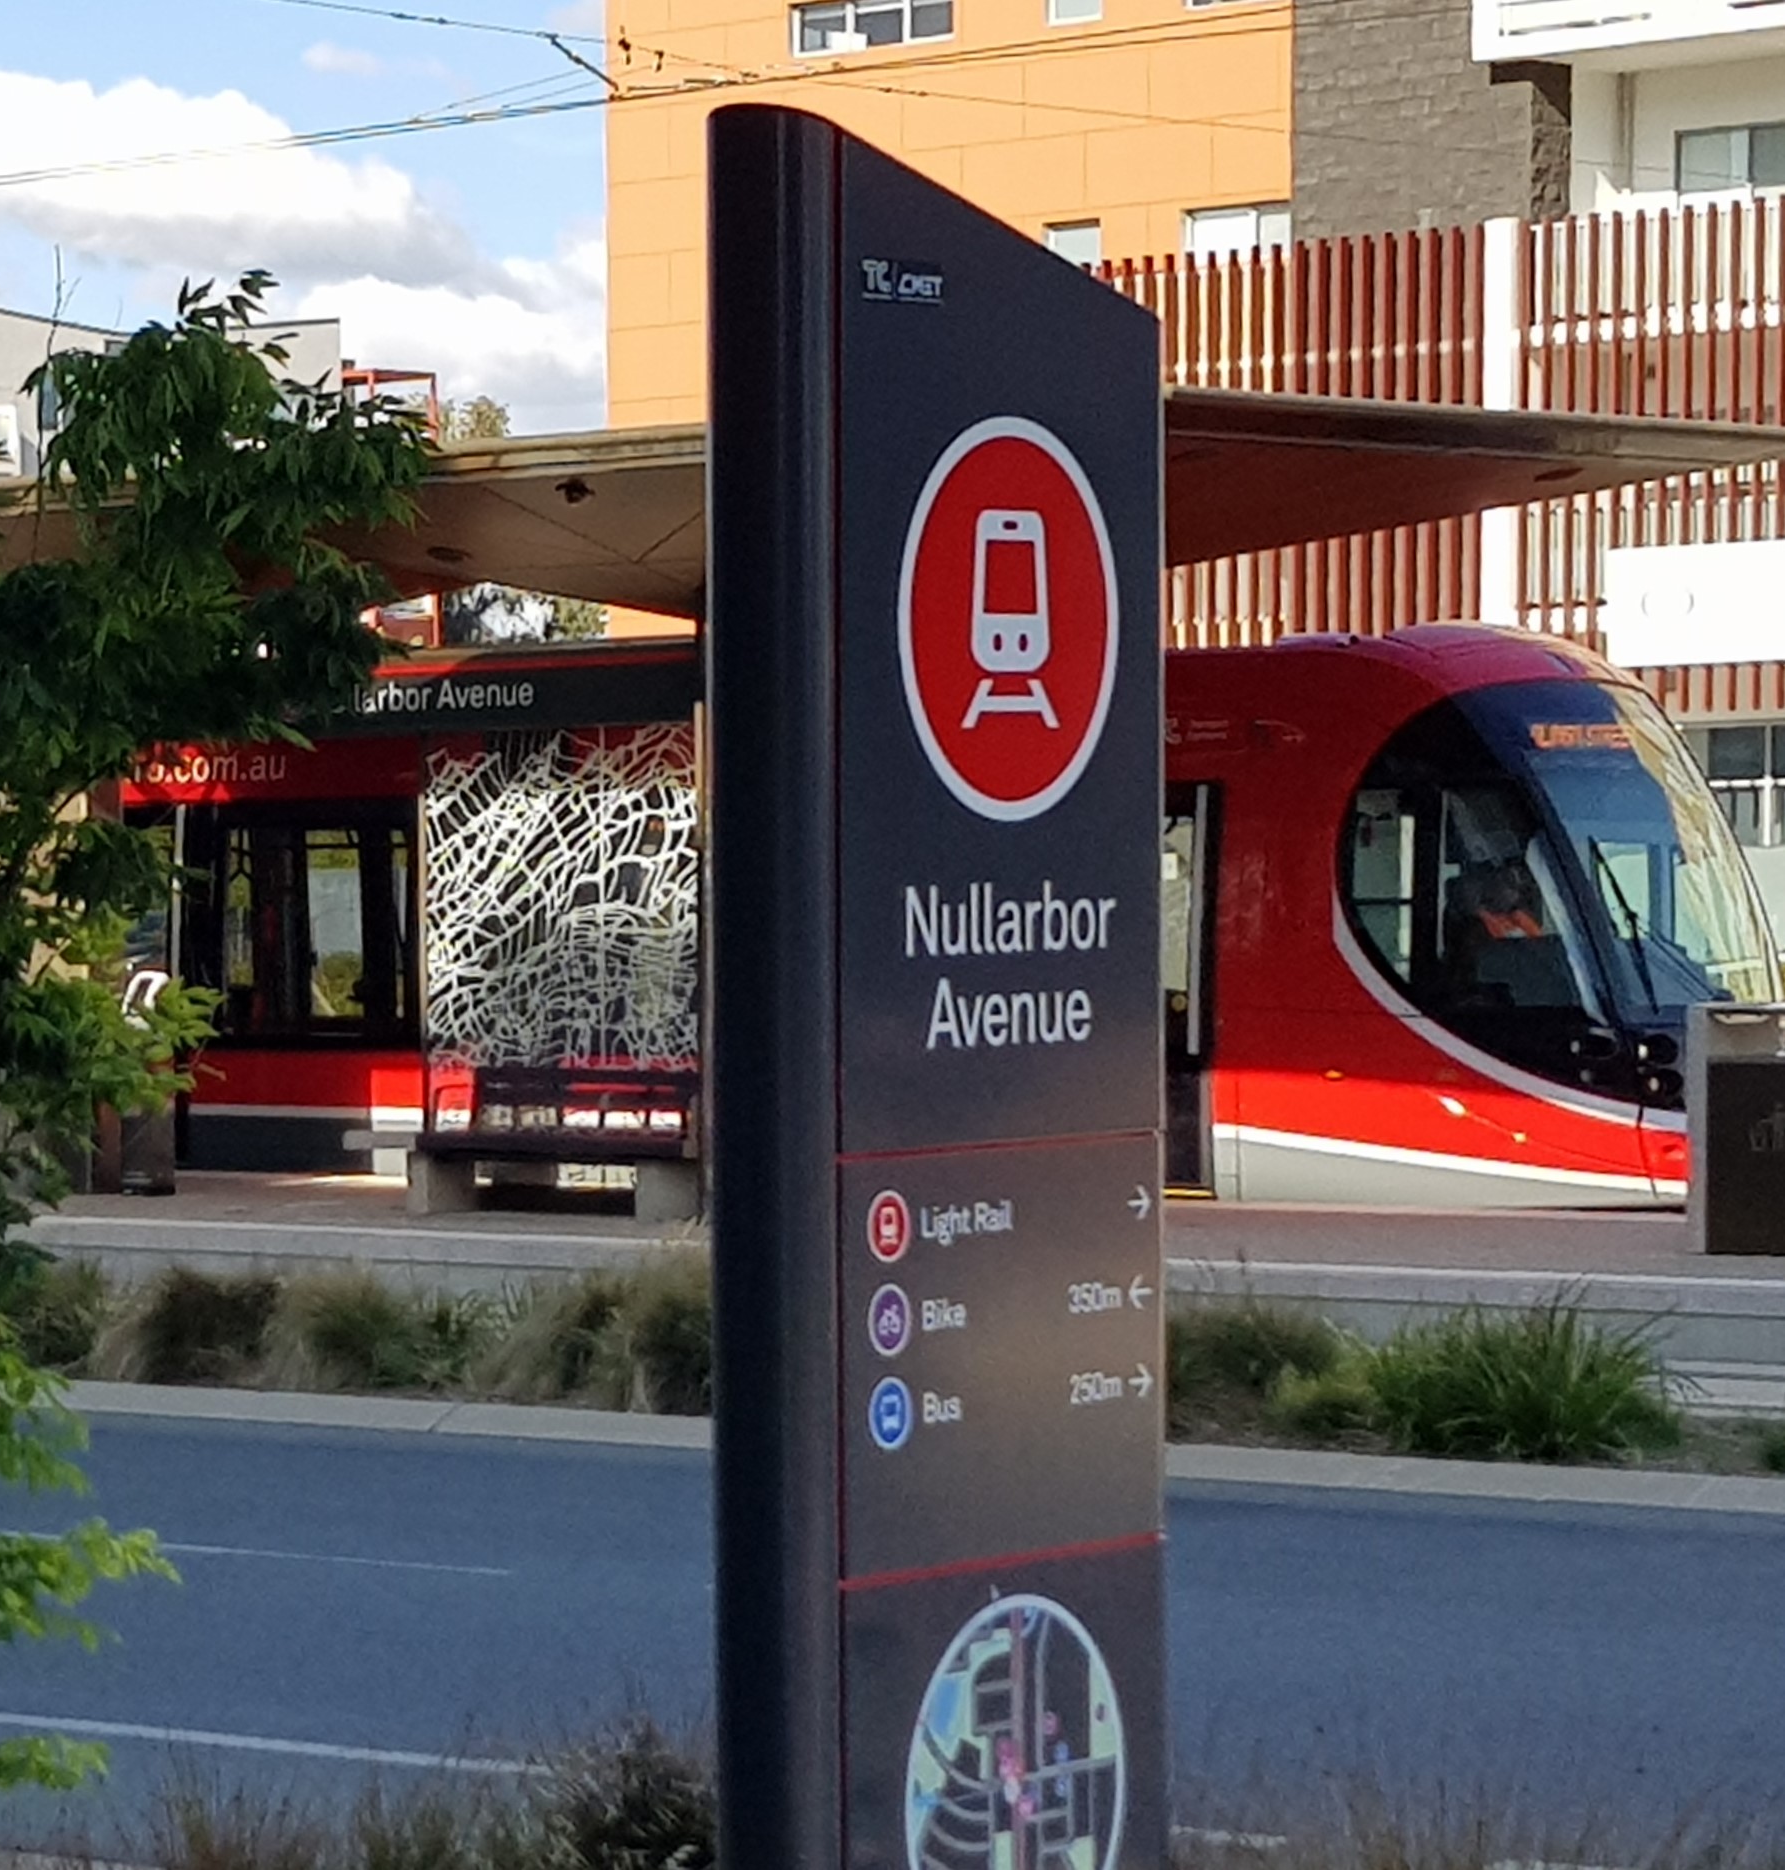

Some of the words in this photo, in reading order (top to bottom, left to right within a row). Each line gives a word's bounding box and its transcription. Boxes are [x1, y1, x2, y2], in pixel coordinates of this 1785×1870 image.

[353, 680, 432, 714] larbor
[436, 678, 535, 711] Avenue
[904, 878, 1118, 958] Nullarbor
[925, 976, 1093, 1051] Avenue
[919, 1205, 972, 1247] Light
[974, 1199, 1014, 1233] Rail
[921, 1298, 967, 1332] Bike
[1067, 1281, 1123, 1314] 350m
[1069, 1371, 1123, 1405] 250m
[922, 1391, 963, 1425] Bus
